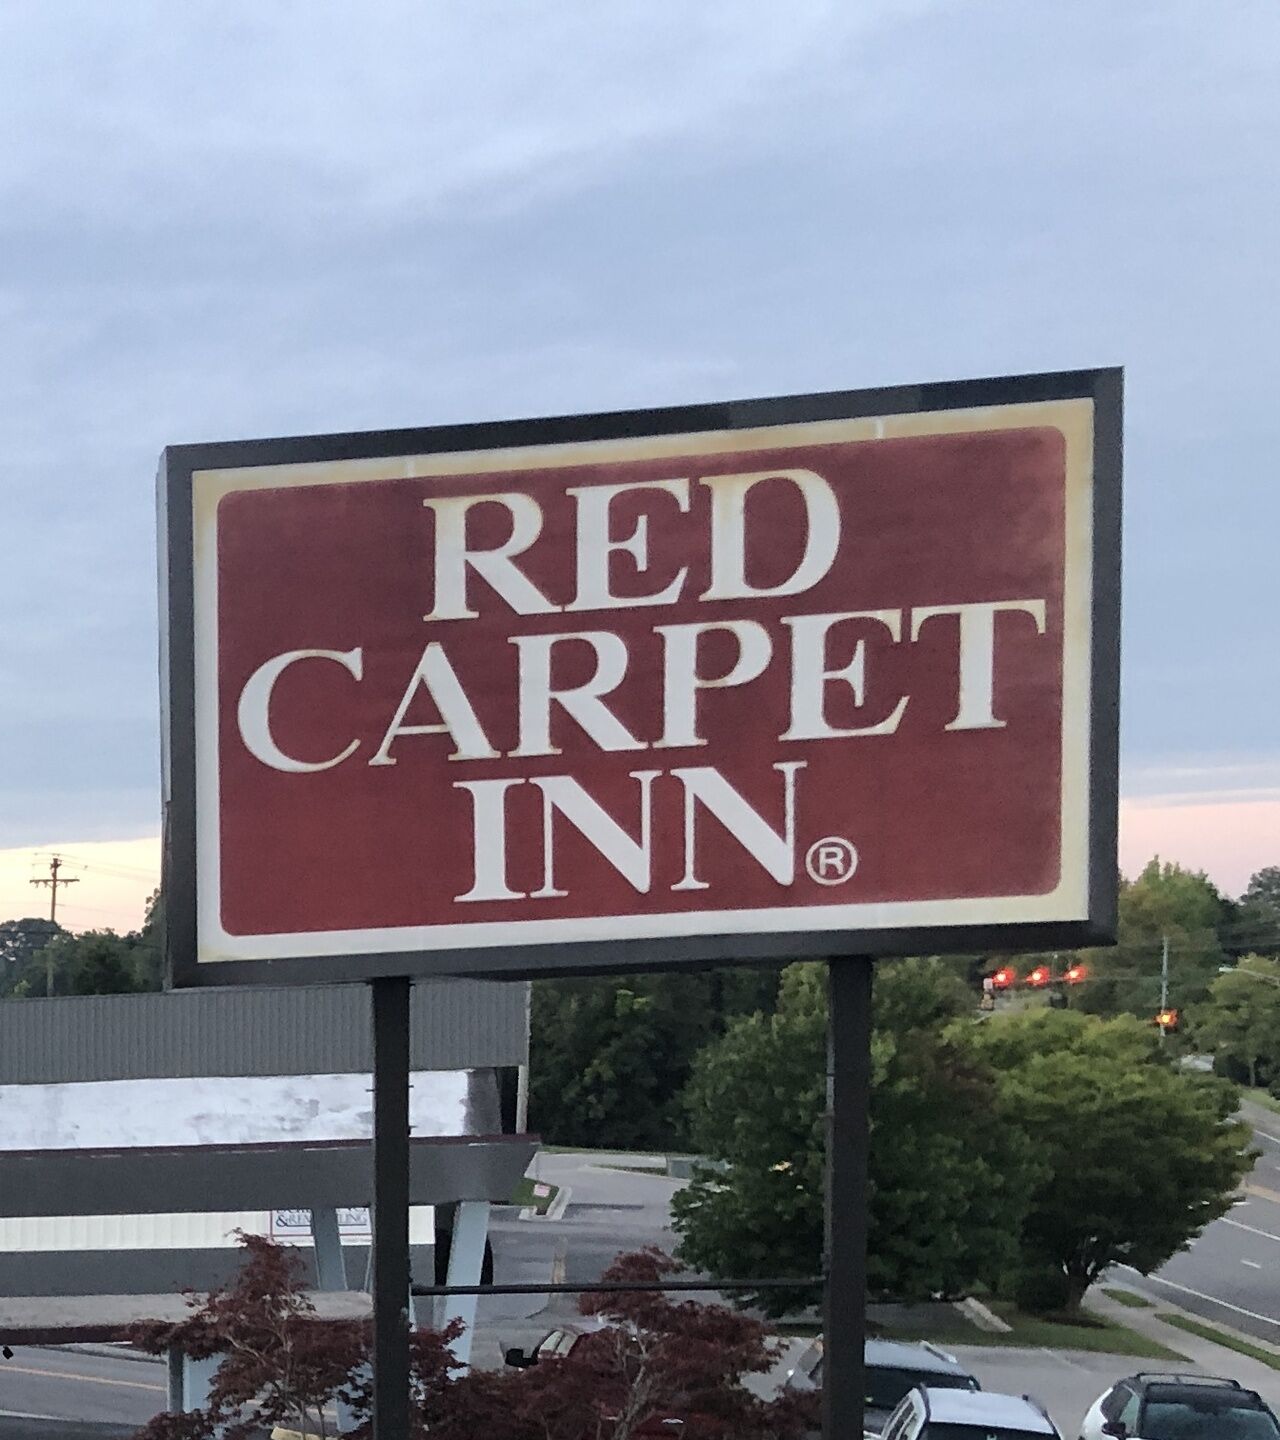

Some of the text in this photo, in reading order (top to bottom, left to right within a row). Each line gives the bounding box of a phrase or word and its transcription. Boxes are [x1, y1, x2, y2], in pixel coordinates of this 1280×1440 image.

[422, 469, 841, 622] RED
[238, 599, 1046, 774] CARPET
[453, 760, 807, 905] INN
